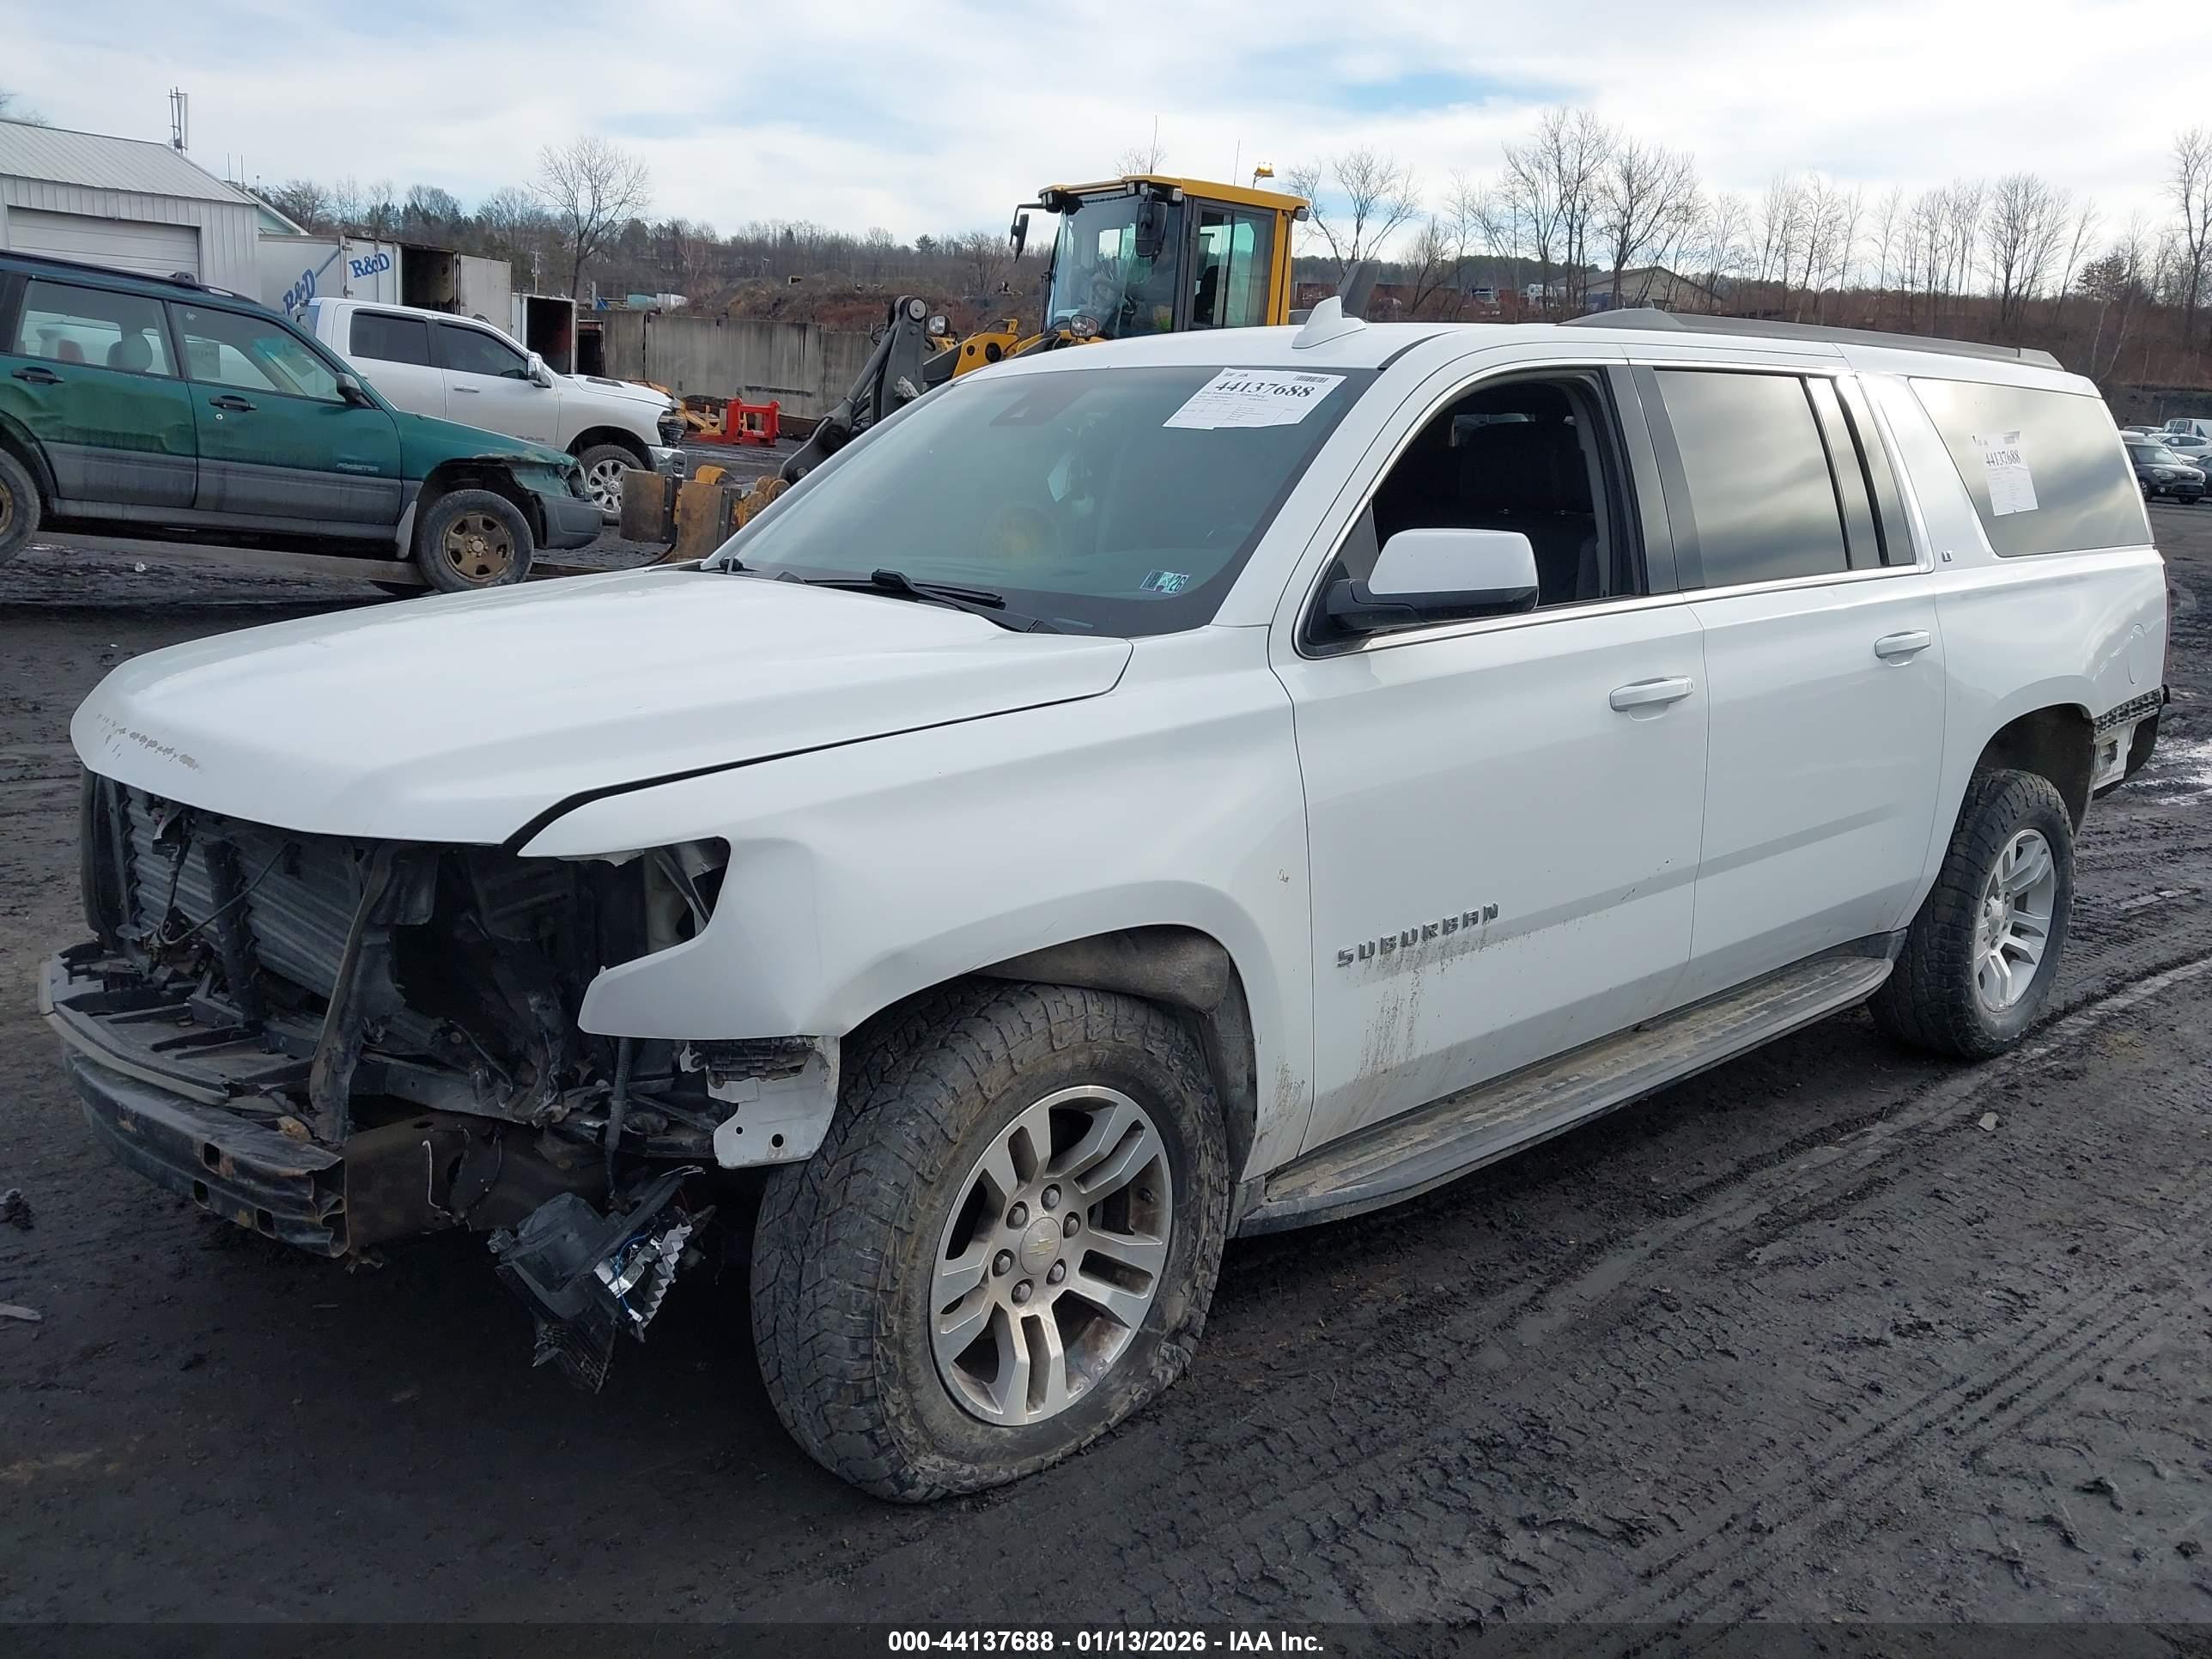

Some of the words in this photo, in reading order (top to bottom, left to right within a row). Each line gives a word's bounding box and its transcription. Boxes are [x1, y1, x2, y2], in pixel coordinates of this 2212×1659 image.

[349, 252, 390, 278] R&D
[283, 269, 316, 316] R&D
[1215, 380, 1316, 398] 44137688
[1985, 449, 2021, 467] 44137688
[1336, 902, 1499, 968] SUBURBAN
